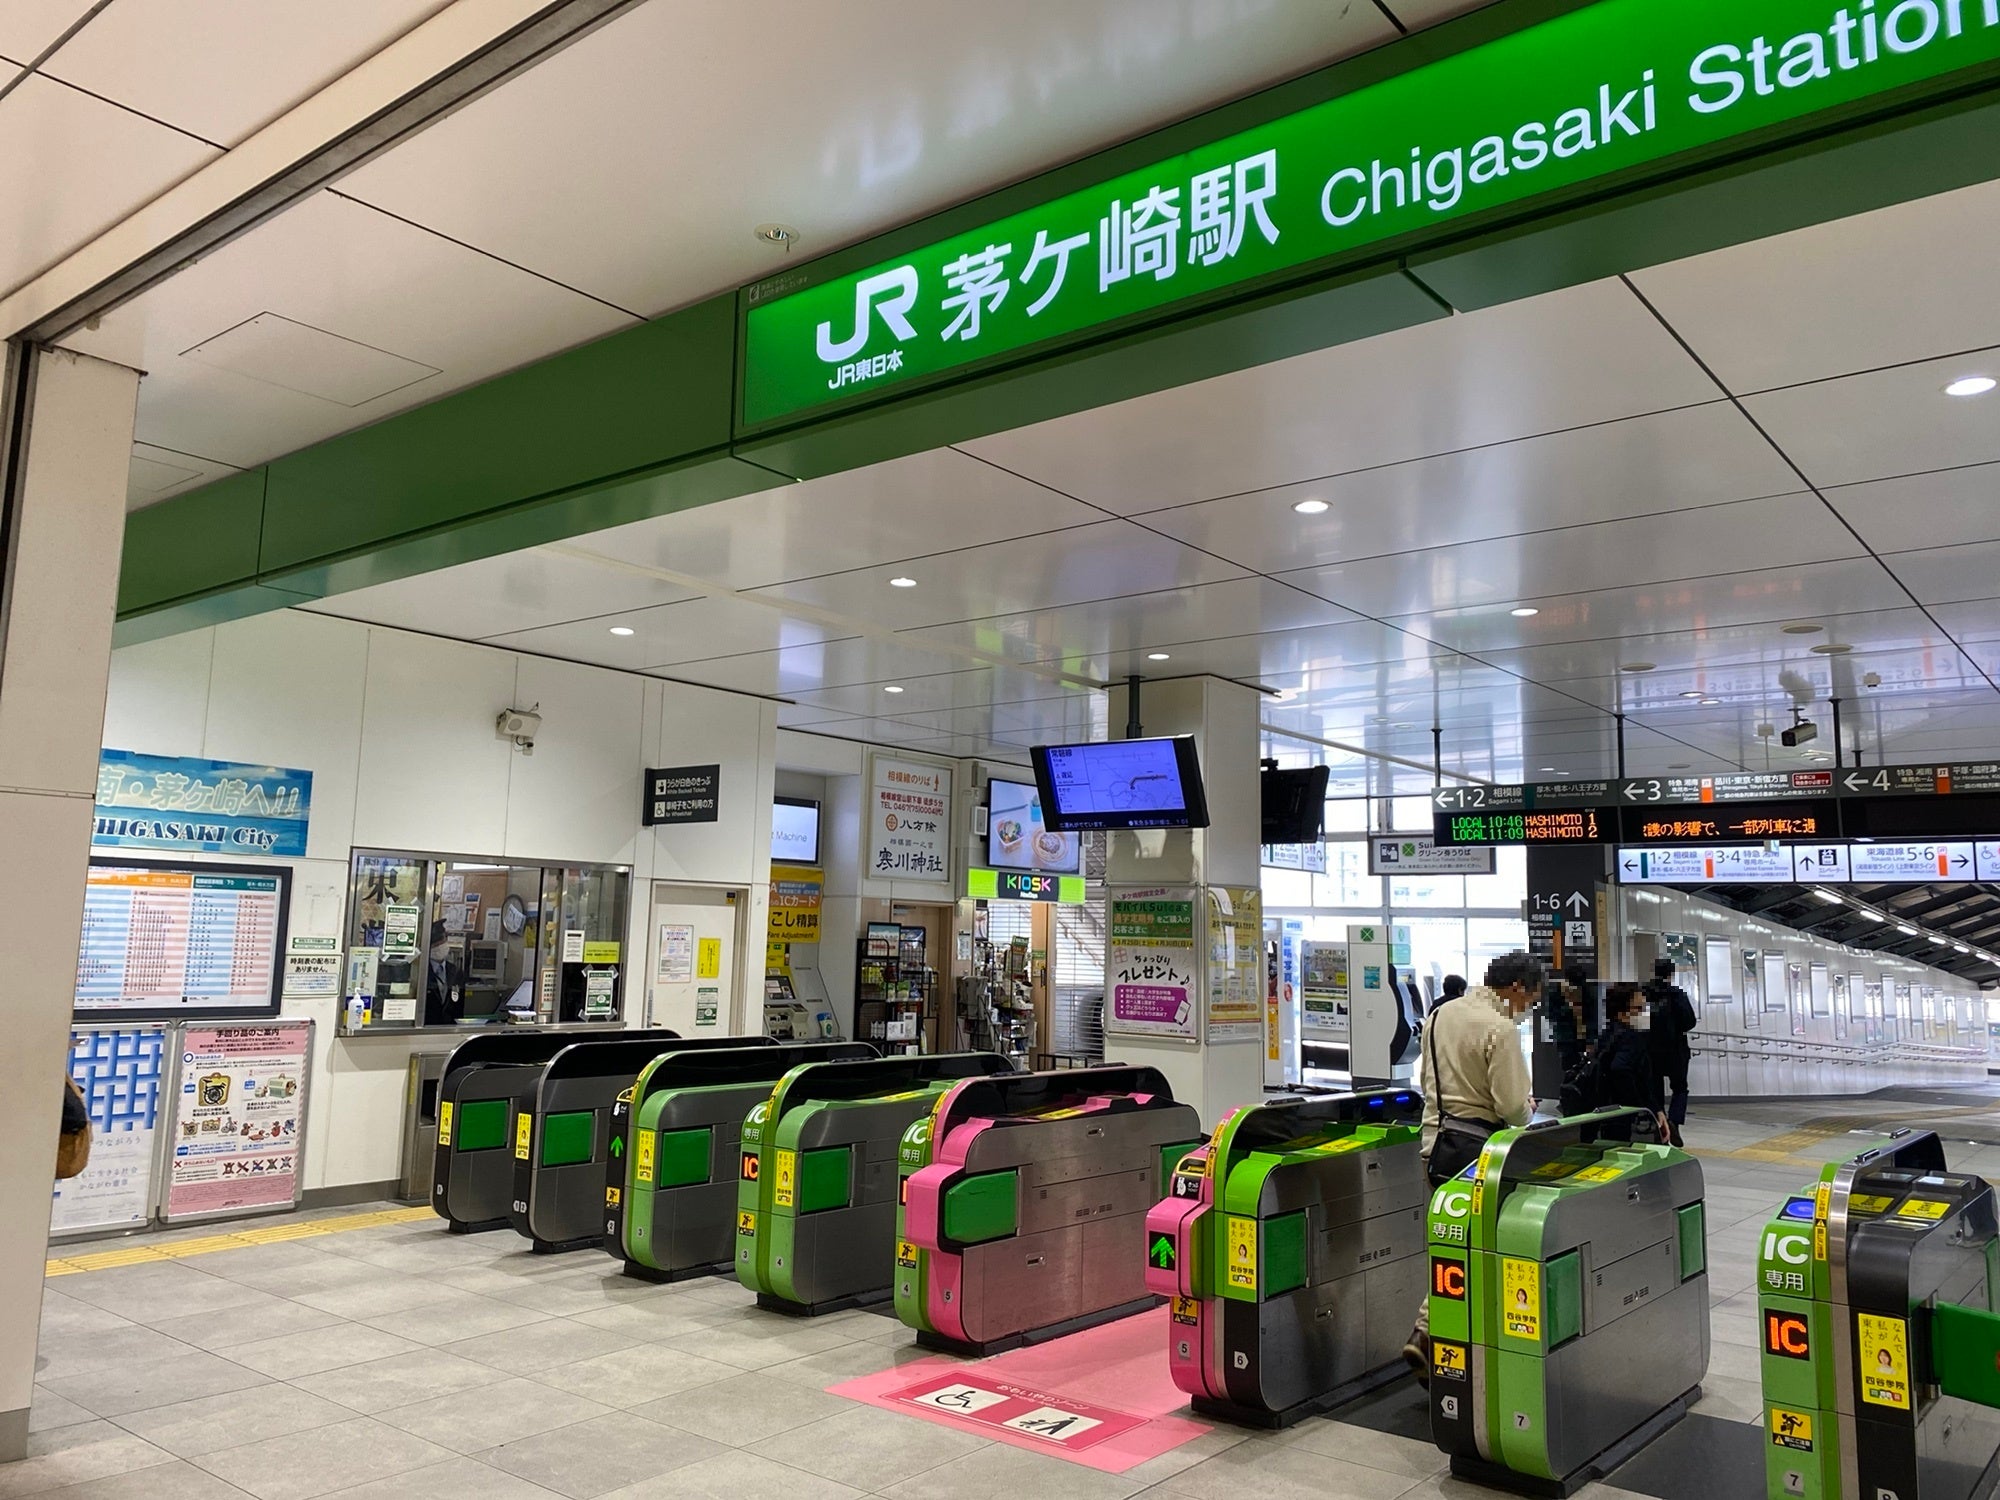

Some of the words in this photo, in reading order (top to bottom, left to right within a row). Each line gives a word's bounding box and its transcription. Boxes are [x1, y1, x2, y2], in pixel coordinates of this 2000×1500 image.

[1320, 69, 1658, 231] Chigasaki
[1688, 0, 2000, 113] Station
[816, 264, 919, 362] JR
[828, 349, 903, 389] JR東日本
[887, 770, 932, 787] 相模線のりば
[1872, 769, 1891, 791] 4
[1493, 787, 1522, 797] 相模線
[1647, 780, 1662, 801] 3
[881, 801, 892, 810] TEL
[1452, 816, 1486, 829] LOCAL
[1489, 815, 1523, 828] 10:46
[1525, 813, 1582, 827] HASHIMOTO
[1588, 812, 1596, 826] 1
[93, 816, 228, 844] HIGASAKI
[232, 826, 279, 850] City
[776, 830, 808, 842] Machine
[1453, 829, 1487, 841] LOCAL
[1489, 827, 1524, 840] 11:09
[1526, 826, 1583, 839] HASHIMOTO
[1588, 826, 1598, 838] 2
[1673, 851, 1697, 859] 相模線
[1866, 847, 1904, 856] 東海道線
[876, 847, 943, 873] 寒川神社
[1007, 875, 1051, 892] KIOSK
[779, 895, 817, 907] ICカード
[1113, 925, 1148, 934] お客さまに
[290, 957, 336, 965] 時刻表の配布は
[1135, 955, 1171, 965] ちょっぴり
[1118, 965, 1178, 983] プレゼント
[216, 1028, 280, 1038] 手回り品のご案内
[747, 1105, 766, 1124] IC
[744, 1128, 760, 1140] 専用
[904, 1125, 928, 1145] IC
[902, 1149, 920, 1162] 専用
[744, 1156, 758, 1178] IC
[1432, 1191, 1471, 1218] IC
[1432, 1222, 1463, 1241] 専用
[743, 1250, 748, 1259] 3
[1764, 1232, 1810, 1264] IC
[777, 1258, 782, 1266] 4
[1231, 1265, 1254, 1275] 四谷学院
[1517, 1264, 1525, 1281] 私が
[1436, 1264, 1465, 1296] IC
[1765, 1269, 1803, 1291] 専用
[903, 1284, 909, 1293] 4
[945, 1291, 951, 1300] 5
[1507, 1312, 1537, 1324] 四谷学院
[1769, 1317, 1807, 1354] IC
[1878, 1320, 1888, 1341] 私が
[1181, 1344, 1188, 1353] 5
[1237, 1355, 1243, 1365] 6
[1865, 1376, 1905, 1390] 四谷学院
[1447, 1400, 1454, 1411] 6
[1517, 1415, 1525, 1426] 7
[1790, 1474, 1799, 1486] 7
